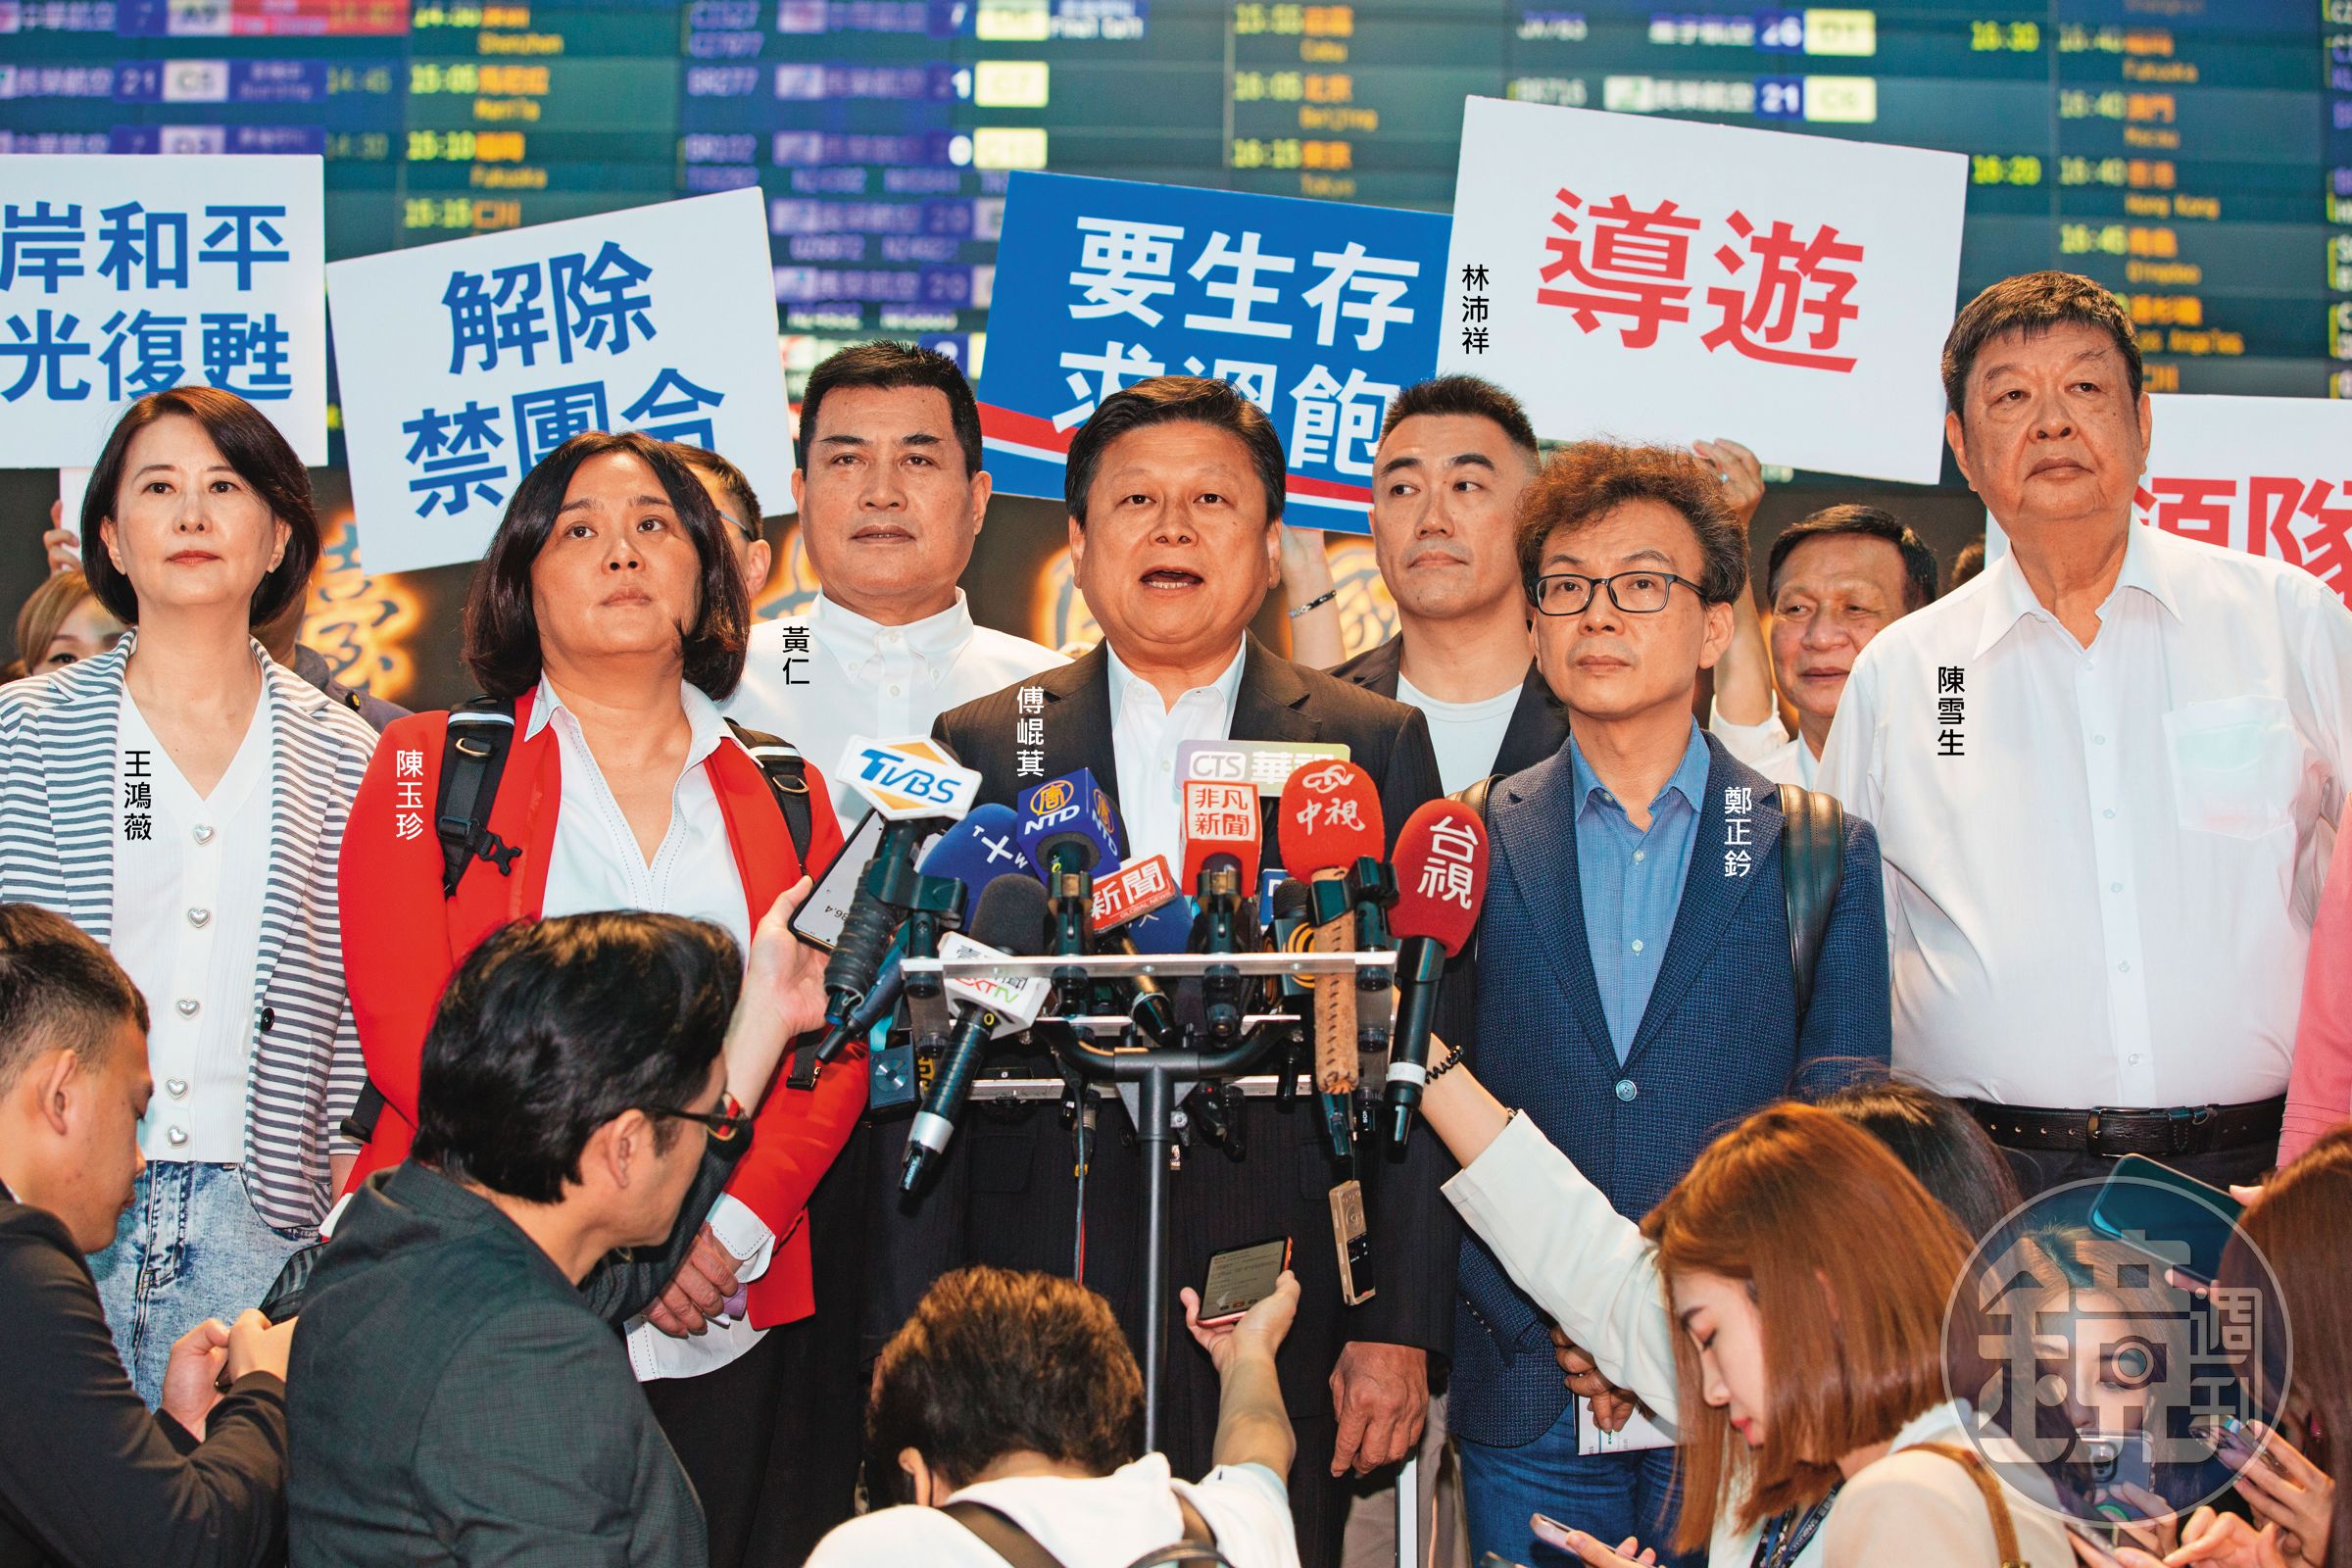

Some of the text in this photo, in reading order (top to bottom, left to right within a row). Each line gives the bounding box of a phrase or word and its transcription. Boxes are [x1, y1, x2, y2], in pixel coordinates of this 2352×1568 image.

[1761, 83, 1800, 113] 21
[0, 199, 291, 294] 岸和平
[441, 241, 658, 374] 解除
[1068, 216, 1420, 352] 要生存
[1537, 187, 1864, 373] 導遊
[0, 309, 294, 402] 光復甦
[859, 748, 961, 805] TVBS
[1192, 754, 1242, 779] CTS
[1024, 805, 1080, 835] NTD
[1195, 788, 1249, 810] 非凡
[1195, 811, 1250, 837] 新聞
[1296, 797, 1367, 836] 中視
[1091, 859, 1166, 921] 新聞
[1417, 815, 1479, 910] 台視
